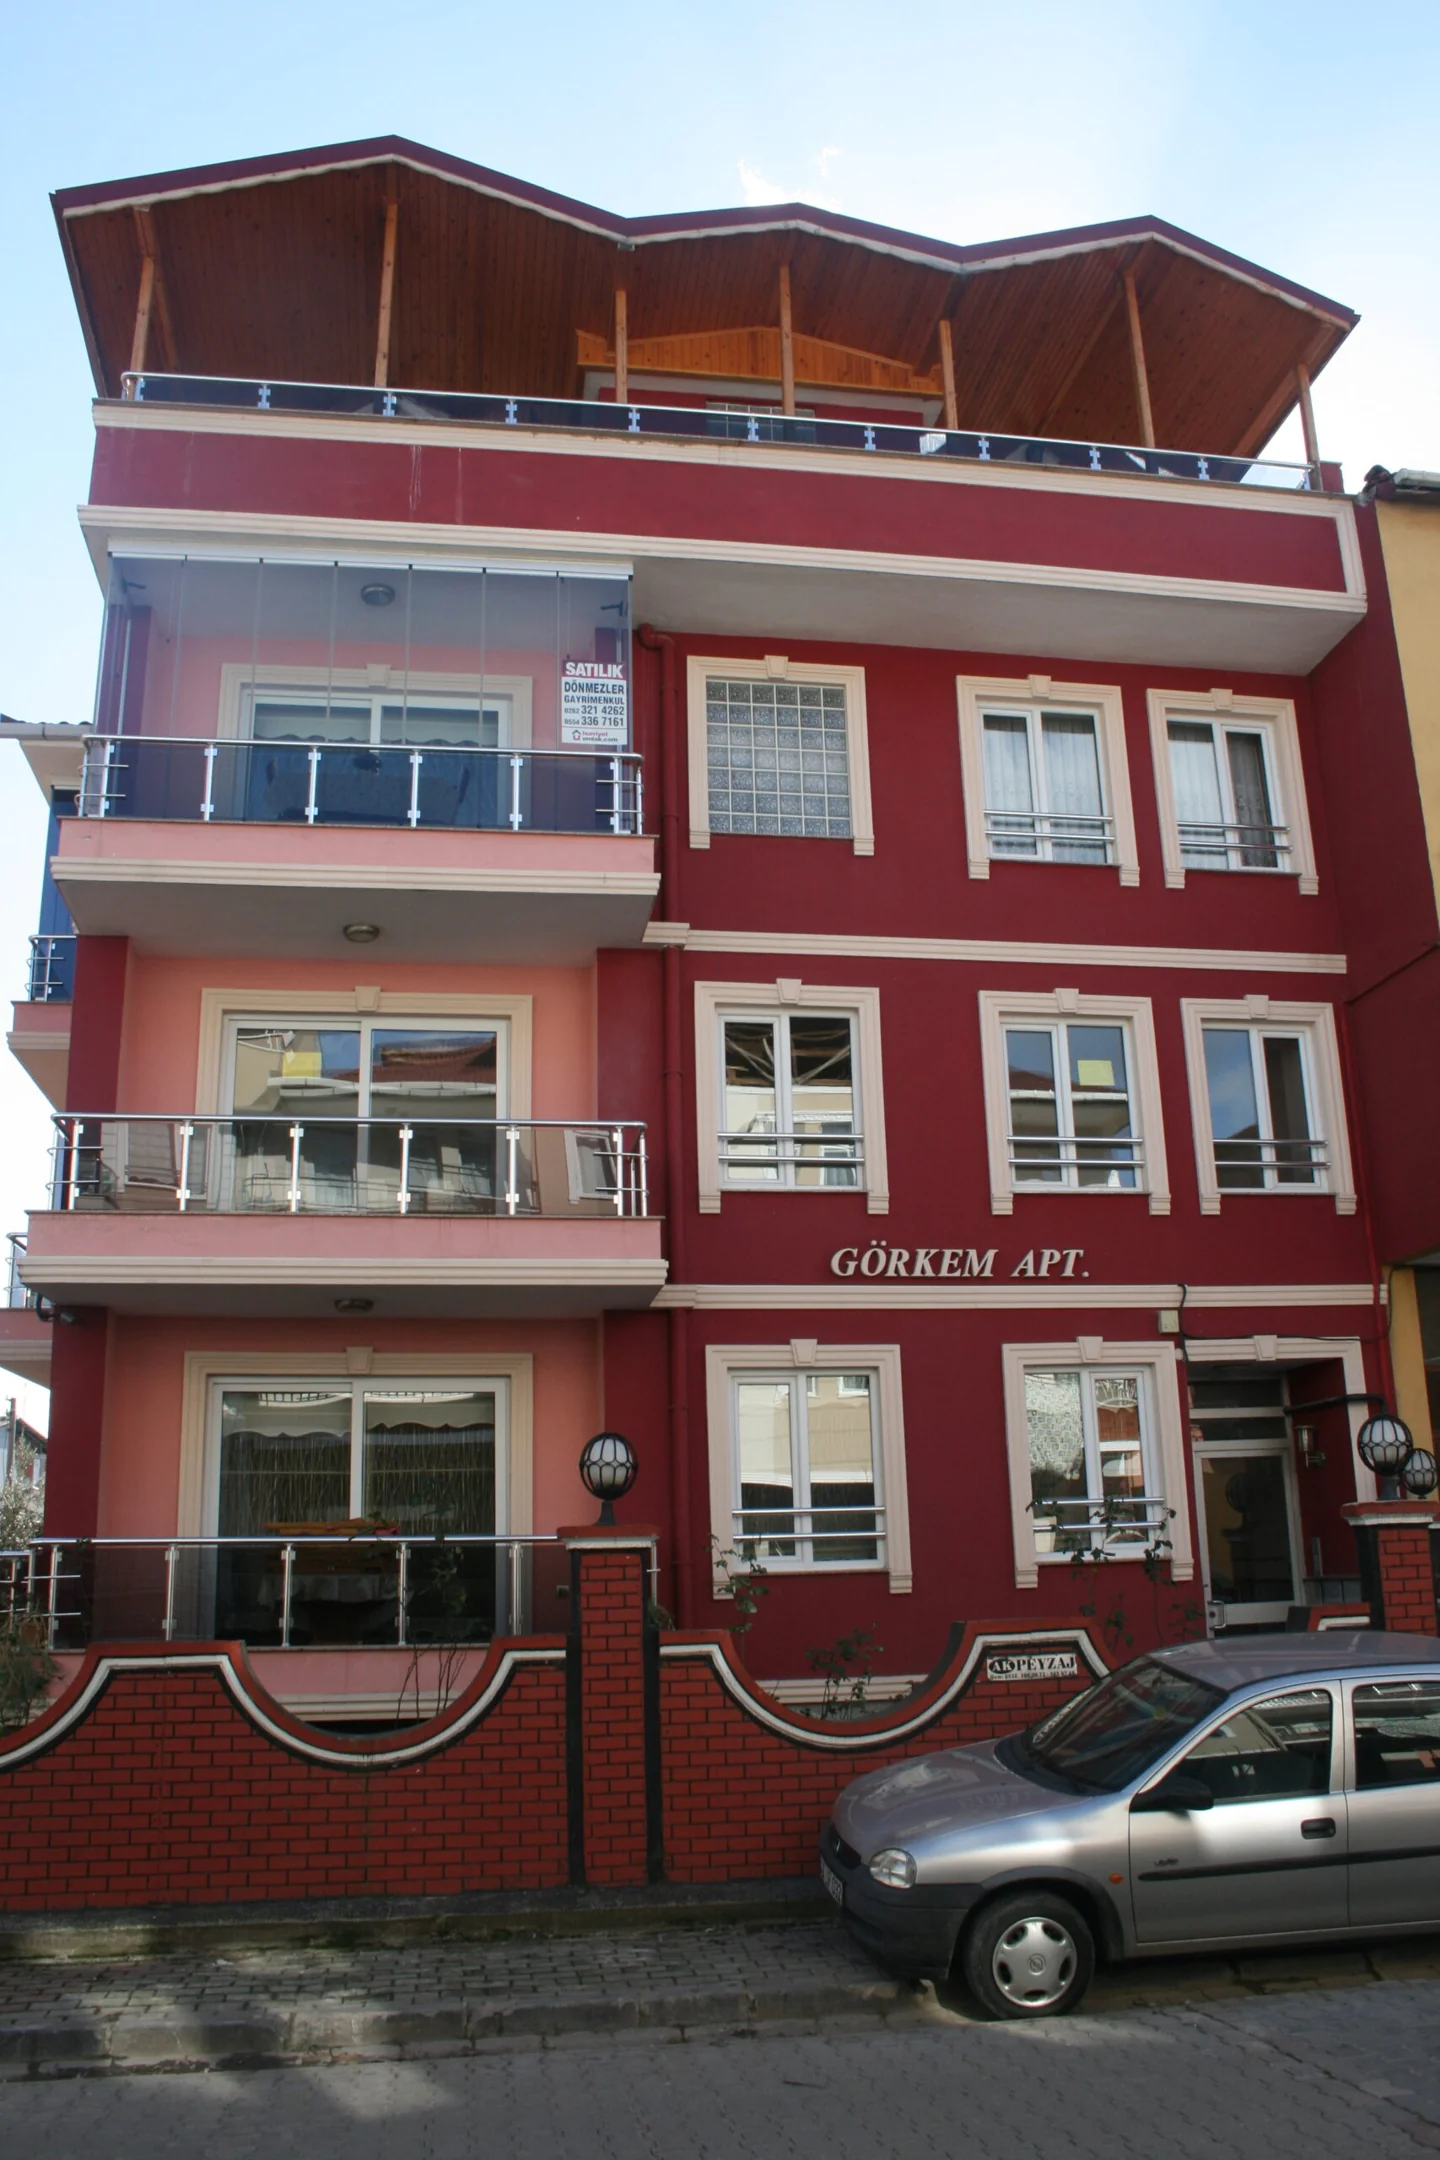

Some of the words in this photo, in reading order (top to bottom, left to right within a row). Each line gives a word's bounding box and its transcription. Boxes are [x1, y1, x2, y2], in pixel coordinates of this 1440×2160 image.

[565, 662, 624, 678] SATILIK
[564, 680, 624, 694] DÖNMEZLER
[581, 705, 598, 714] 321
[601, 706, 625, 716] 4262
[581, 716, 599, 726] 336
[602, 717, 624, 727] 7161
[830, 1240, 999, 1278] GÖRKEM
[1010, 1249, 1090, 1278] APT.
[991, 1660, 1013, 1672] AK
[1016, 1656, 1076, 1671] PEYZAJ
